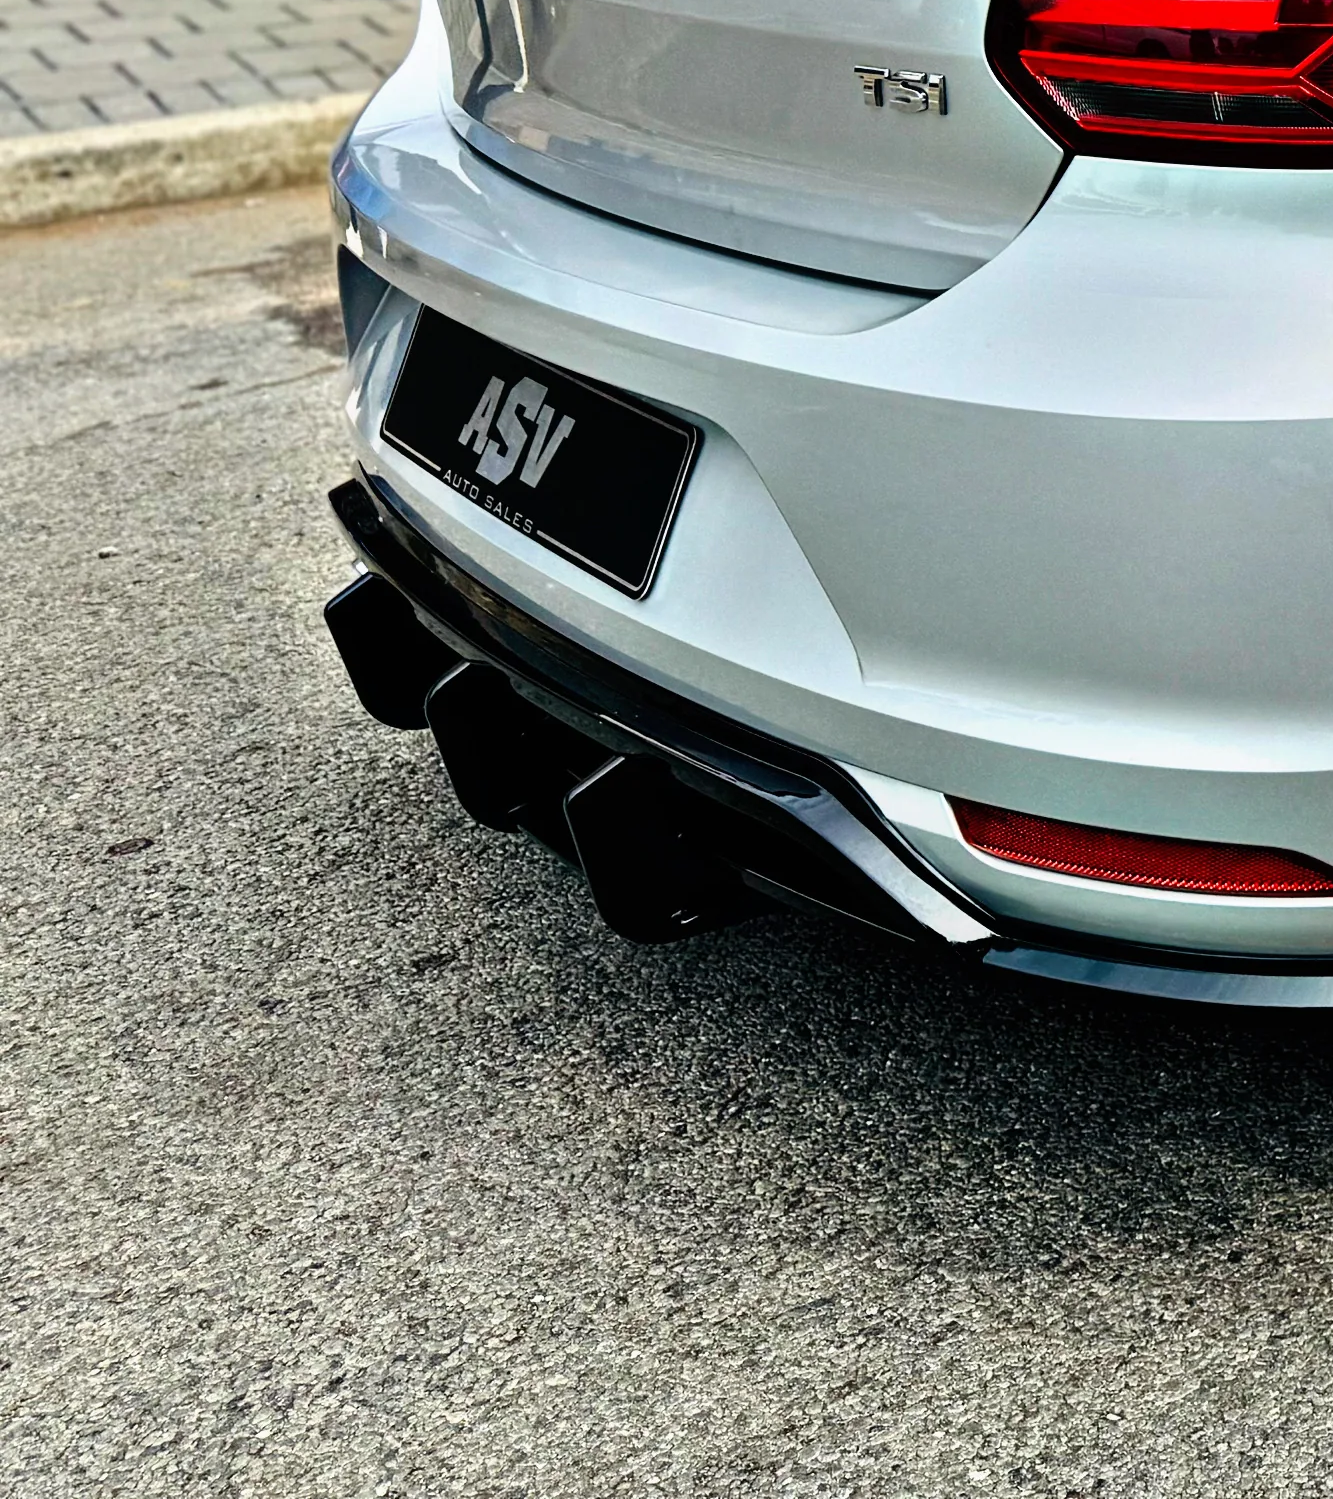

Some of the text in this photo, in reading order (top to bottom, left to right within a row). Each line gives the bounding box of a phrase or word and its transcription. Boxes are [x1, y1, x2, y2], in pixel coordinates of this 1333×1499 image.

[458, 376, 576, 489] ASV
[442, 469, 536, 535] AUTO SALES
